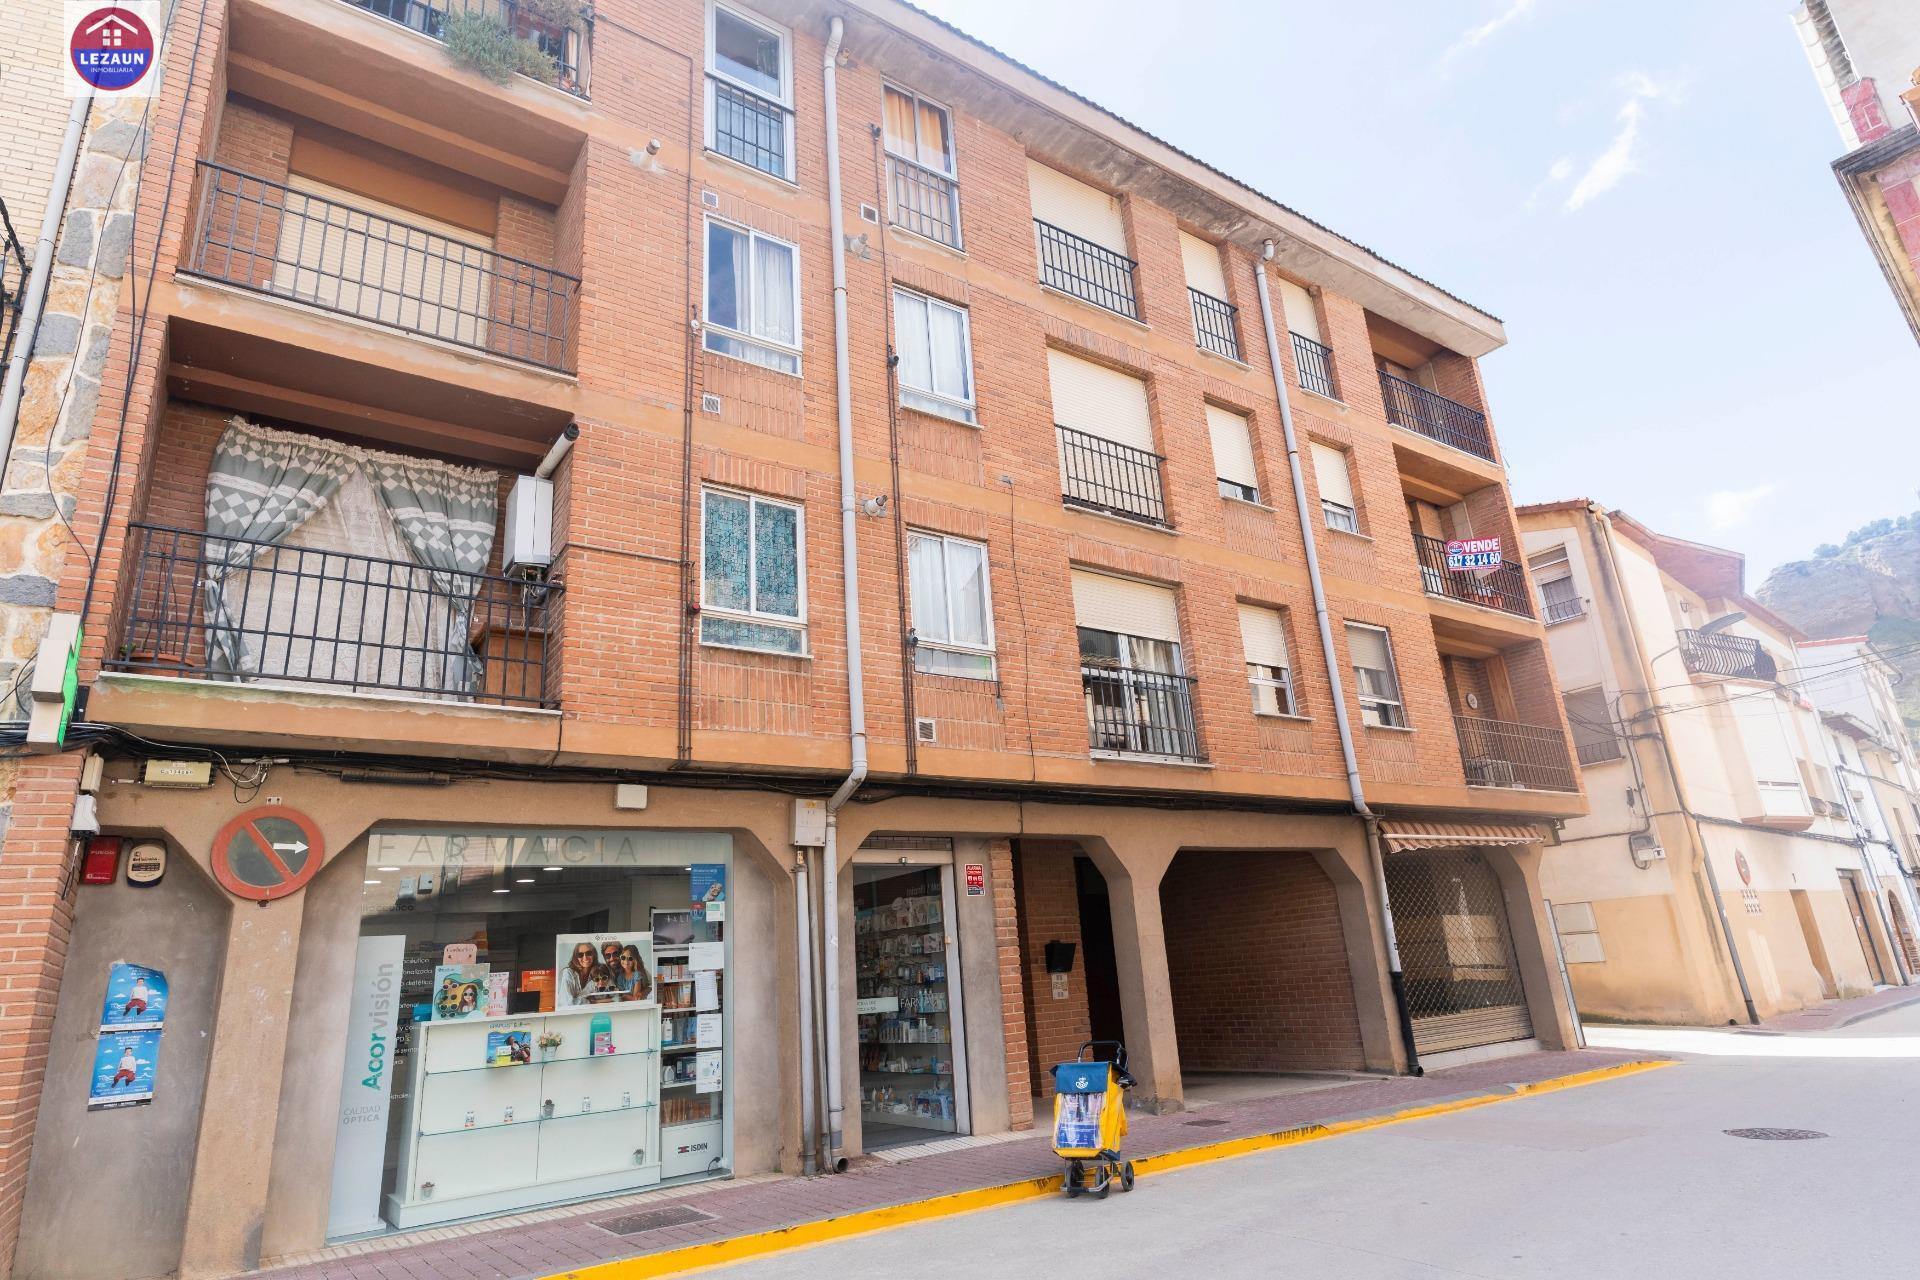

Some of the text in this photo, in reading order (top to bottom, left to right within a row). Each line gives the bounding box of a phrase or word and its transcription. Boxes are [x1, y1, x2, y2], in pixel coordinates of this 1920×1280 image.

[1463, 538, 1499, 553] VENDE
[1448, 555, 1462, 567] 617
[1465, 555, 1475, 566] 32
[1477, 553, 1488, 564] 14
[1489, 552, 1500, 564] 60
[377, 833, 638, 863] FARMACIA
[362, 963, 394, 1091] Acorvisión
[343, 1105, 381, 1116] CALIDAD
[690, 1142, 708, 1152] ISDIN
